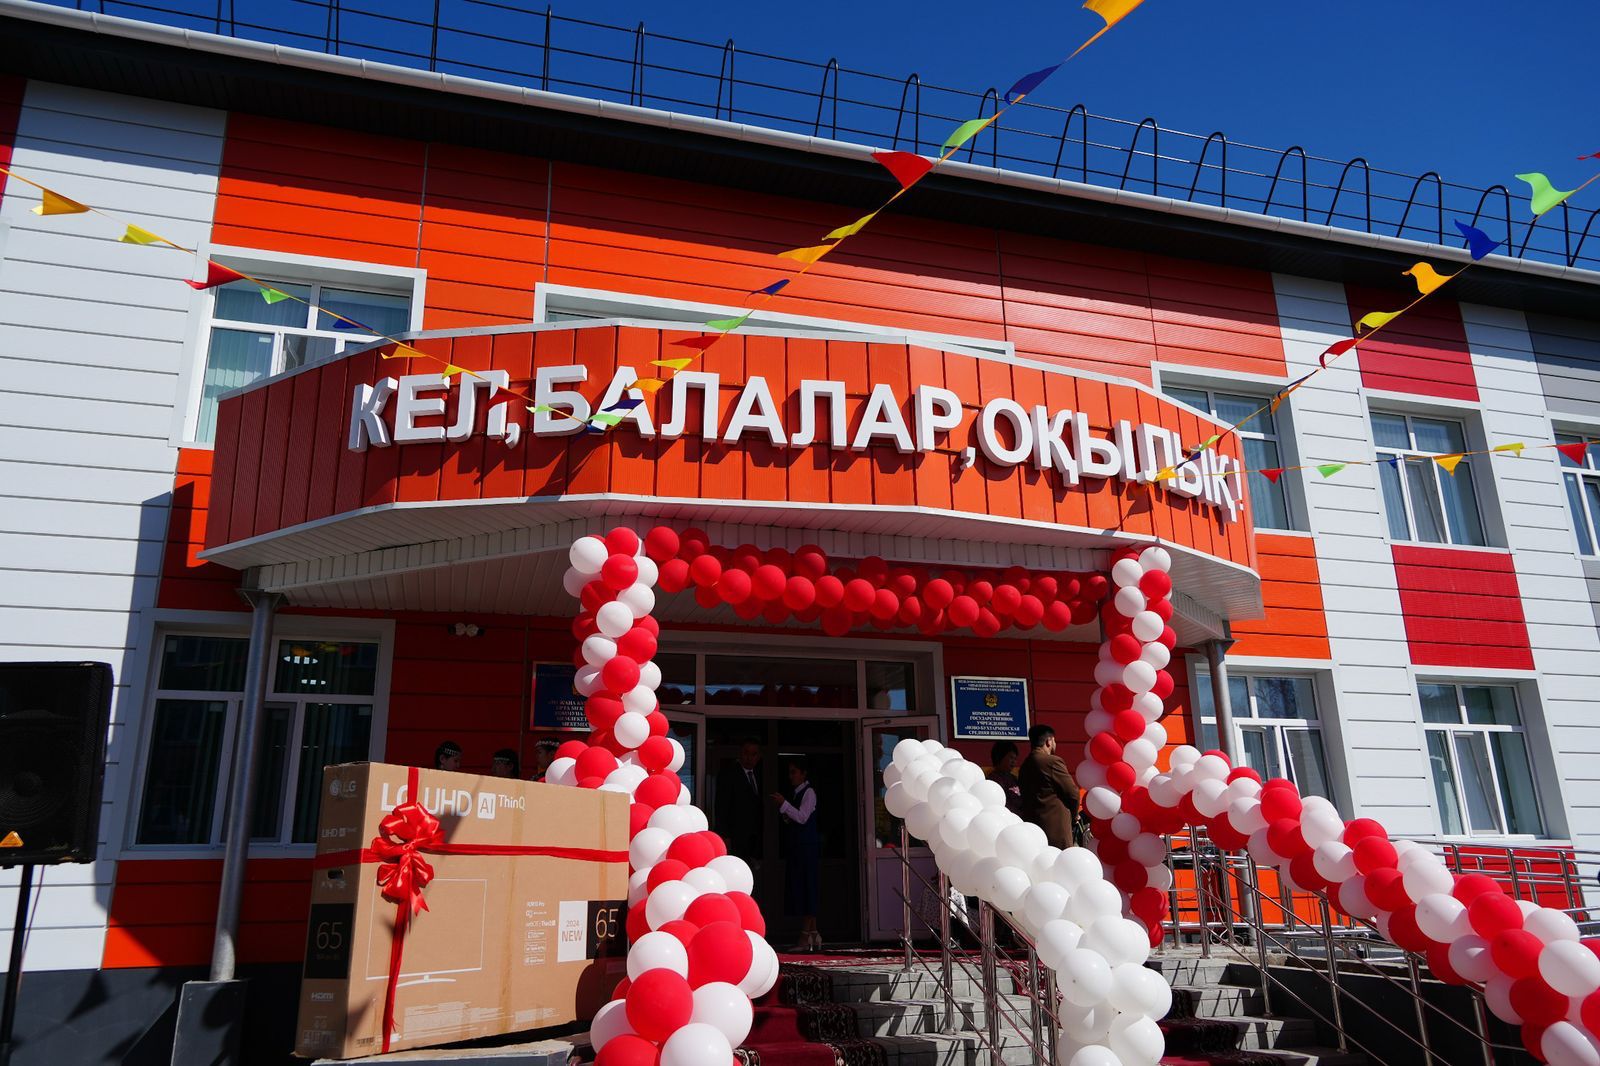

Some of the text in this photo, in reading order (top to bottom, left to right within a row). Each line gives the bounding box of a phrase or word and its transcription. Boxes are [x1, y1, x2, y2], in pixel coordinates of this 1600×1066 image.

[348, 369, 520, 452] КЕЛ,
[533, 364, 976, 470] БАЛАЛАР,
[423, 787, 472, 817] UHD
[479, 796, 495, 816] AI
[497, 794, 526, 811] ThinQ
[316, 921, 343, 950] 65
[561, 930, 583, 942] NEW
[595, 908, 619, 938] 65
